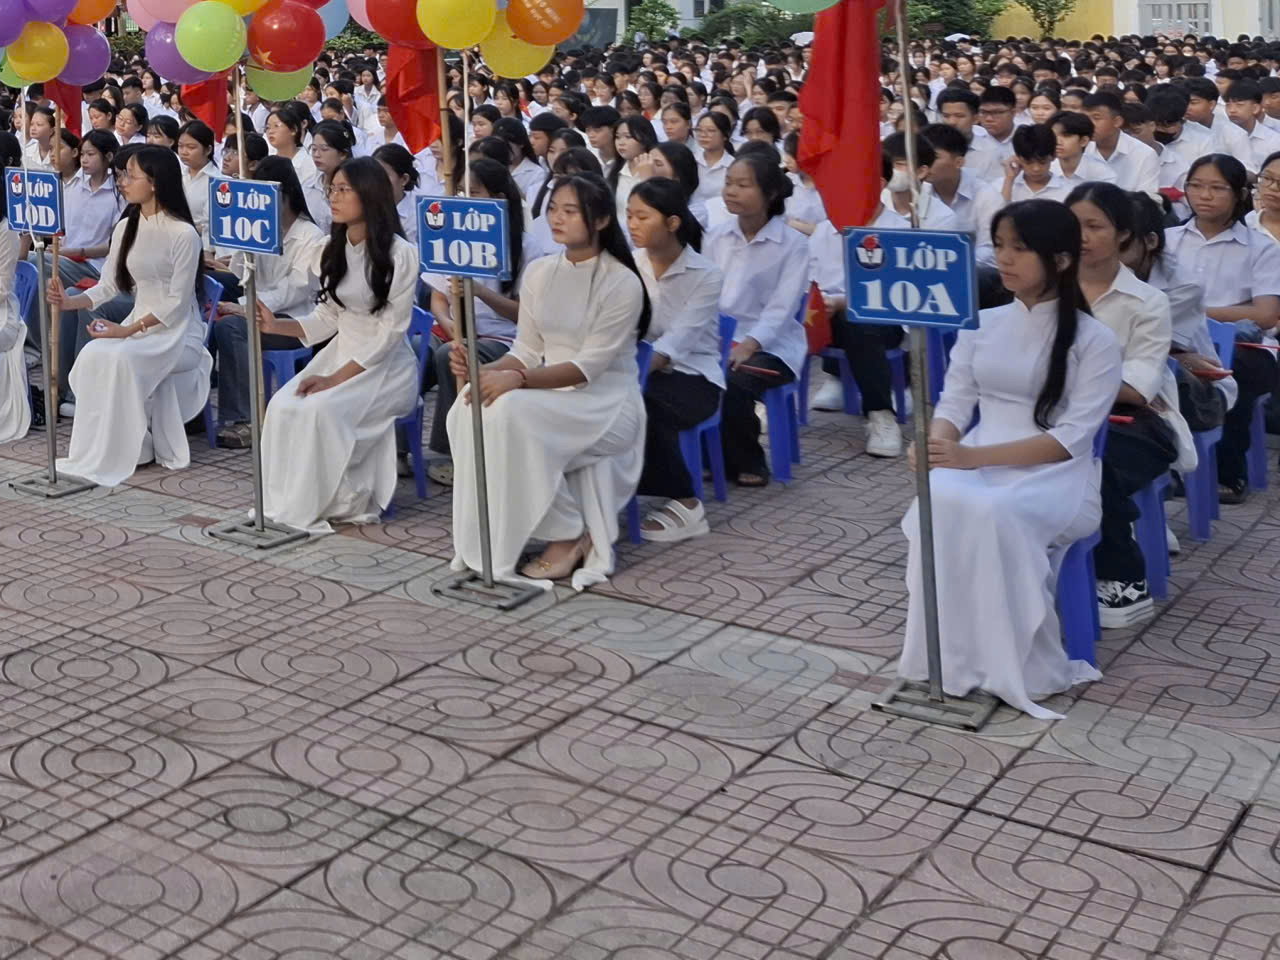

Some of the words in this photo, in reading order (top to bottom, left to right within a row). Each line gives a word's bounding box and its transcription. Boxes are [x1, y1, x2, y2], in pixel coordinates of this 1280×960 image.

[26, 178, 53, 198] LỚP
[237, 188, 271, 211] LỚP
[13, 202, 56, 227] 10D
[452, 207, 496, 232] LỚP
[219, 215, 270, 244] 10C
[428, 238, 498, 268] 10B
[893, 241, 958, 271] LỚP
[858, 279, 960, 316] 10A
